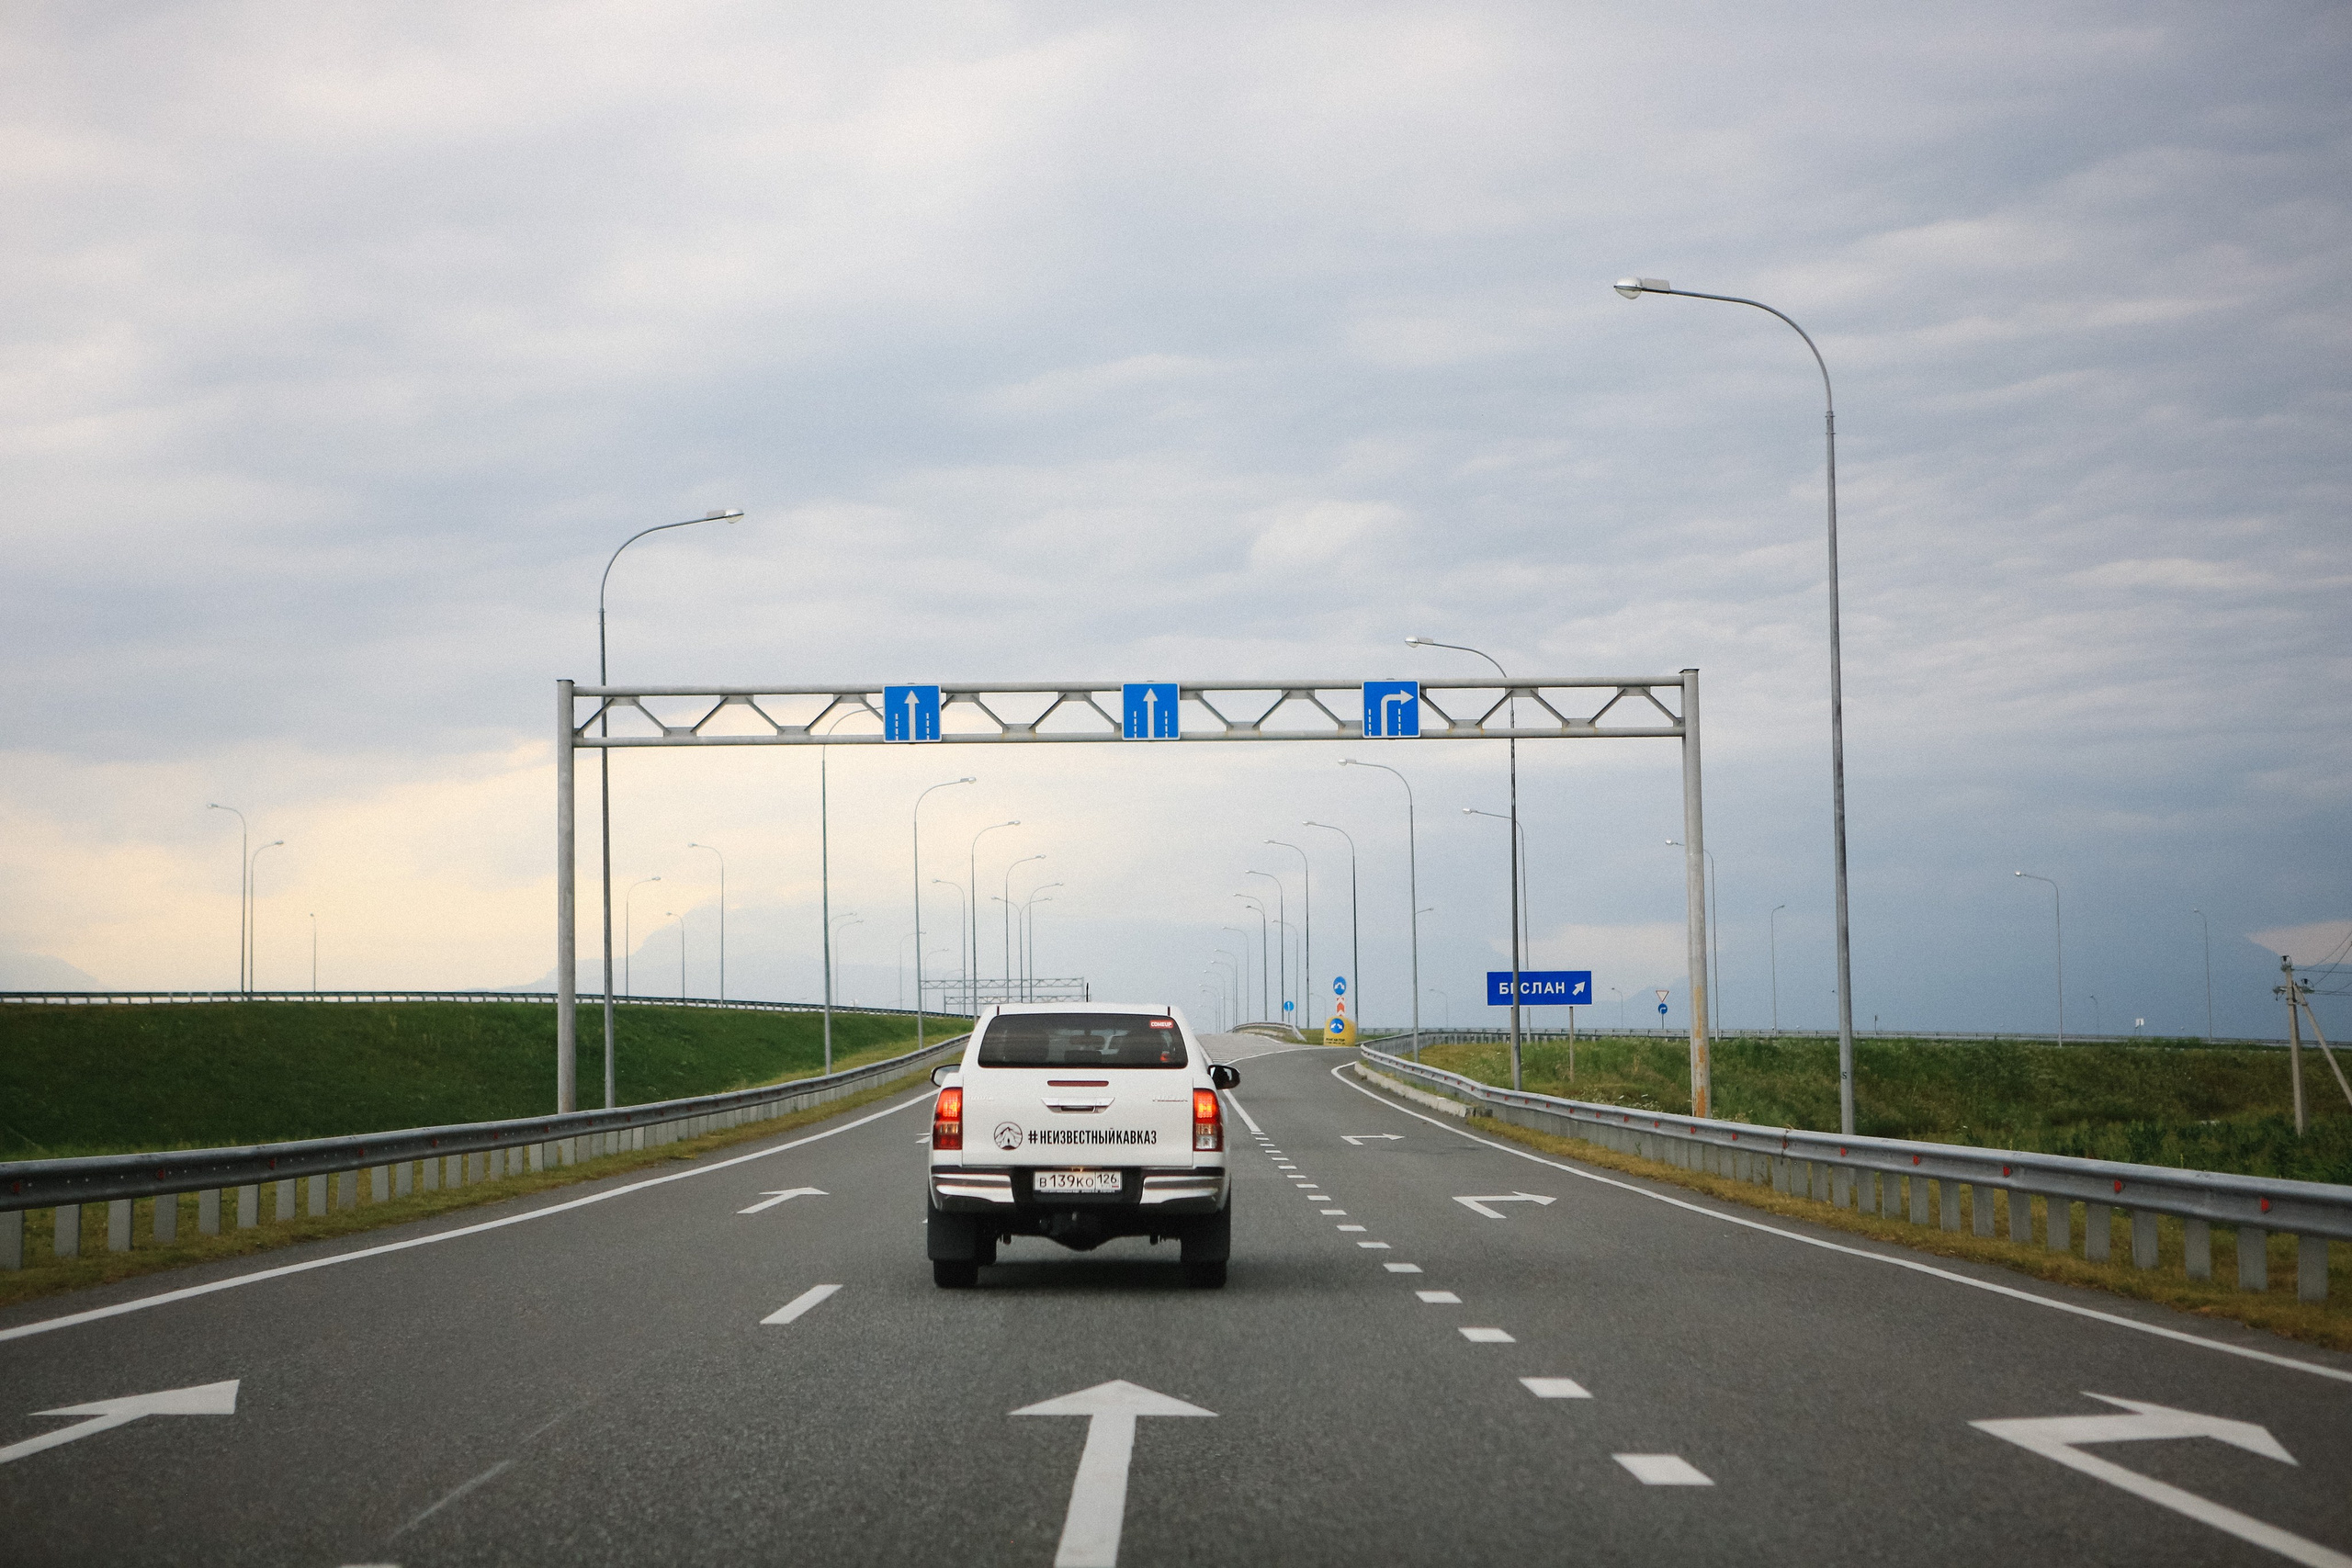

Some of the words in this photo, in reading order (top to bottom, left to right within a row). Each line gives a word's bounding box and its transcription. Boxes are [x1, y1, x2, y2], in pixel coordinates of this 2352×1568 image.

[1498, 981, 1566, 995] БСЛАН
[1028, 1127, 1157, 1145] #НЕИЗВЕСТНЫЙКАВКАЗ
[1097, 1173, 1117, 1185] 126
